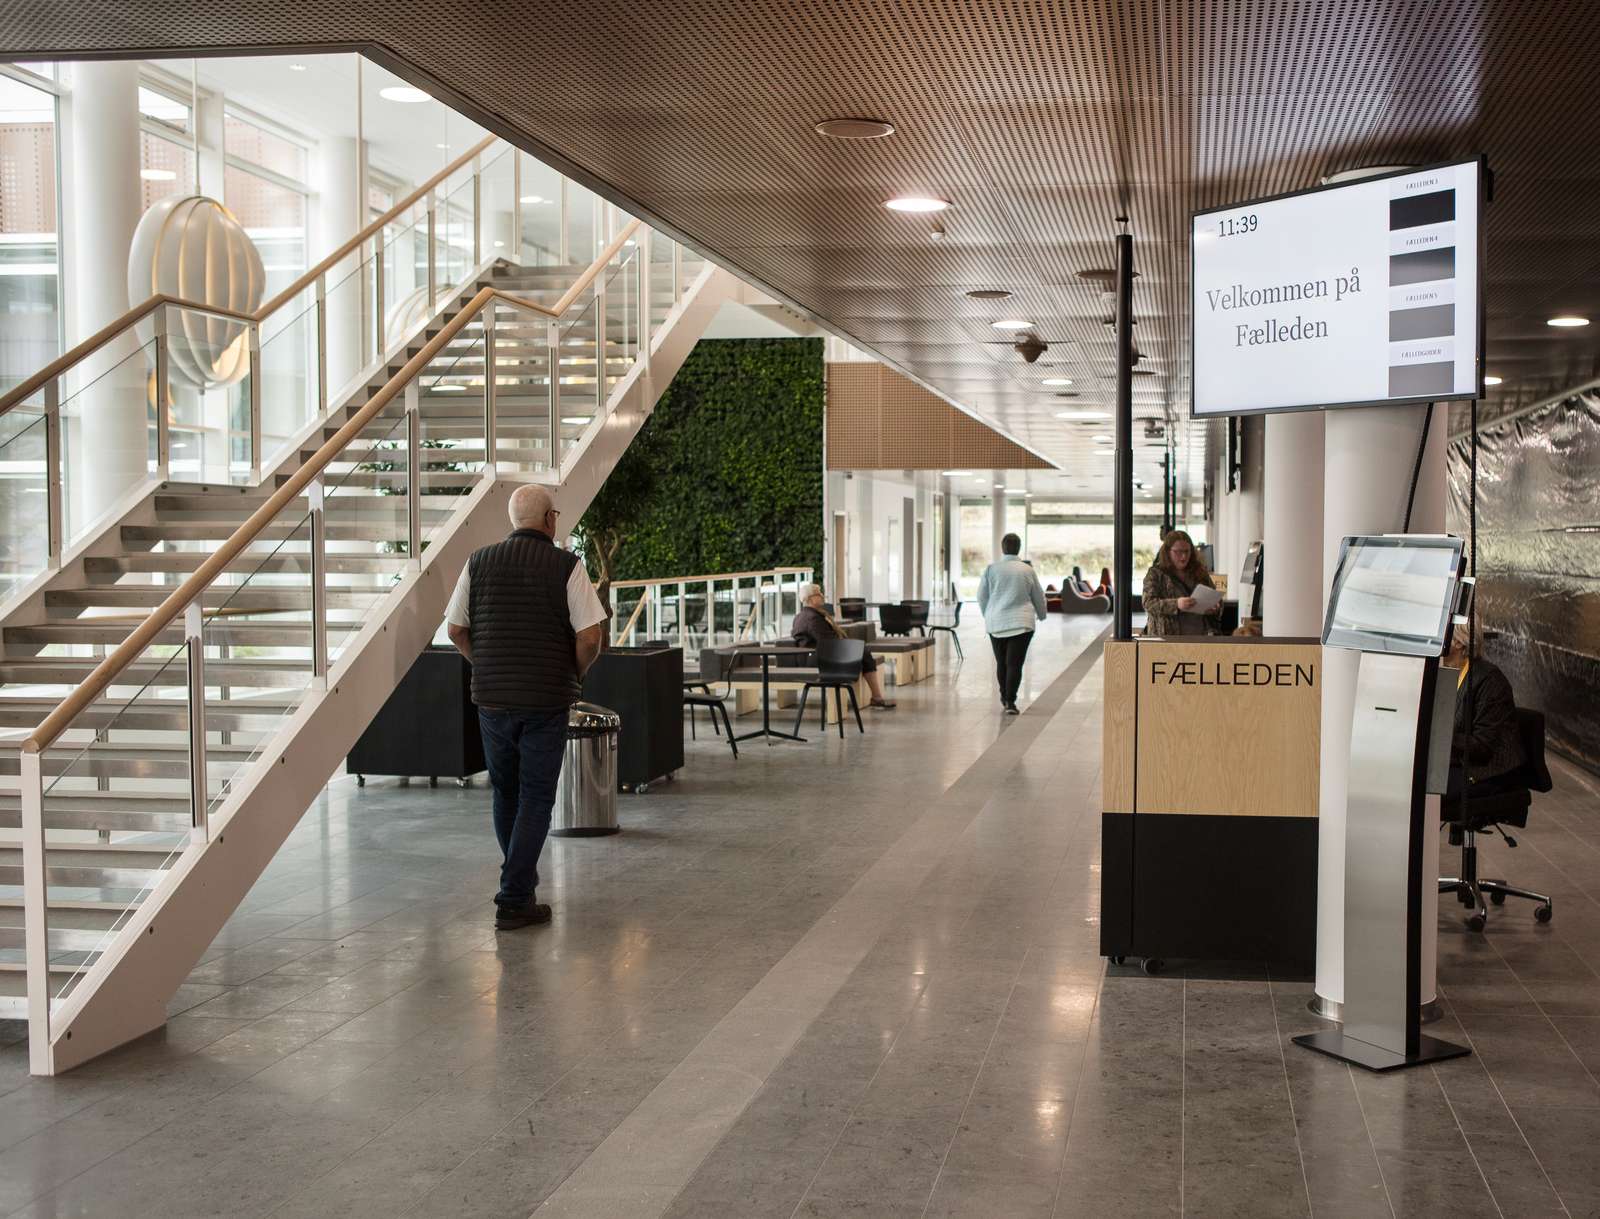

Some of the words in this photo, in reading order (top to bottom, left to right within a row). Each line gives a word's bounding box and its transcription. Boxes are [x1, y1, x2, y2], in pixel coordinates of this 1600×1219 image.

[1218, 214, 1258, 238] 11:39
[1206, 278, 1328, 313] Velkommen
[1335, 266, 1362, 302] på
[1235, 316, 1329, 347] Fælleden
[1151, 662, 1314, 687] FÆLLEDEN
